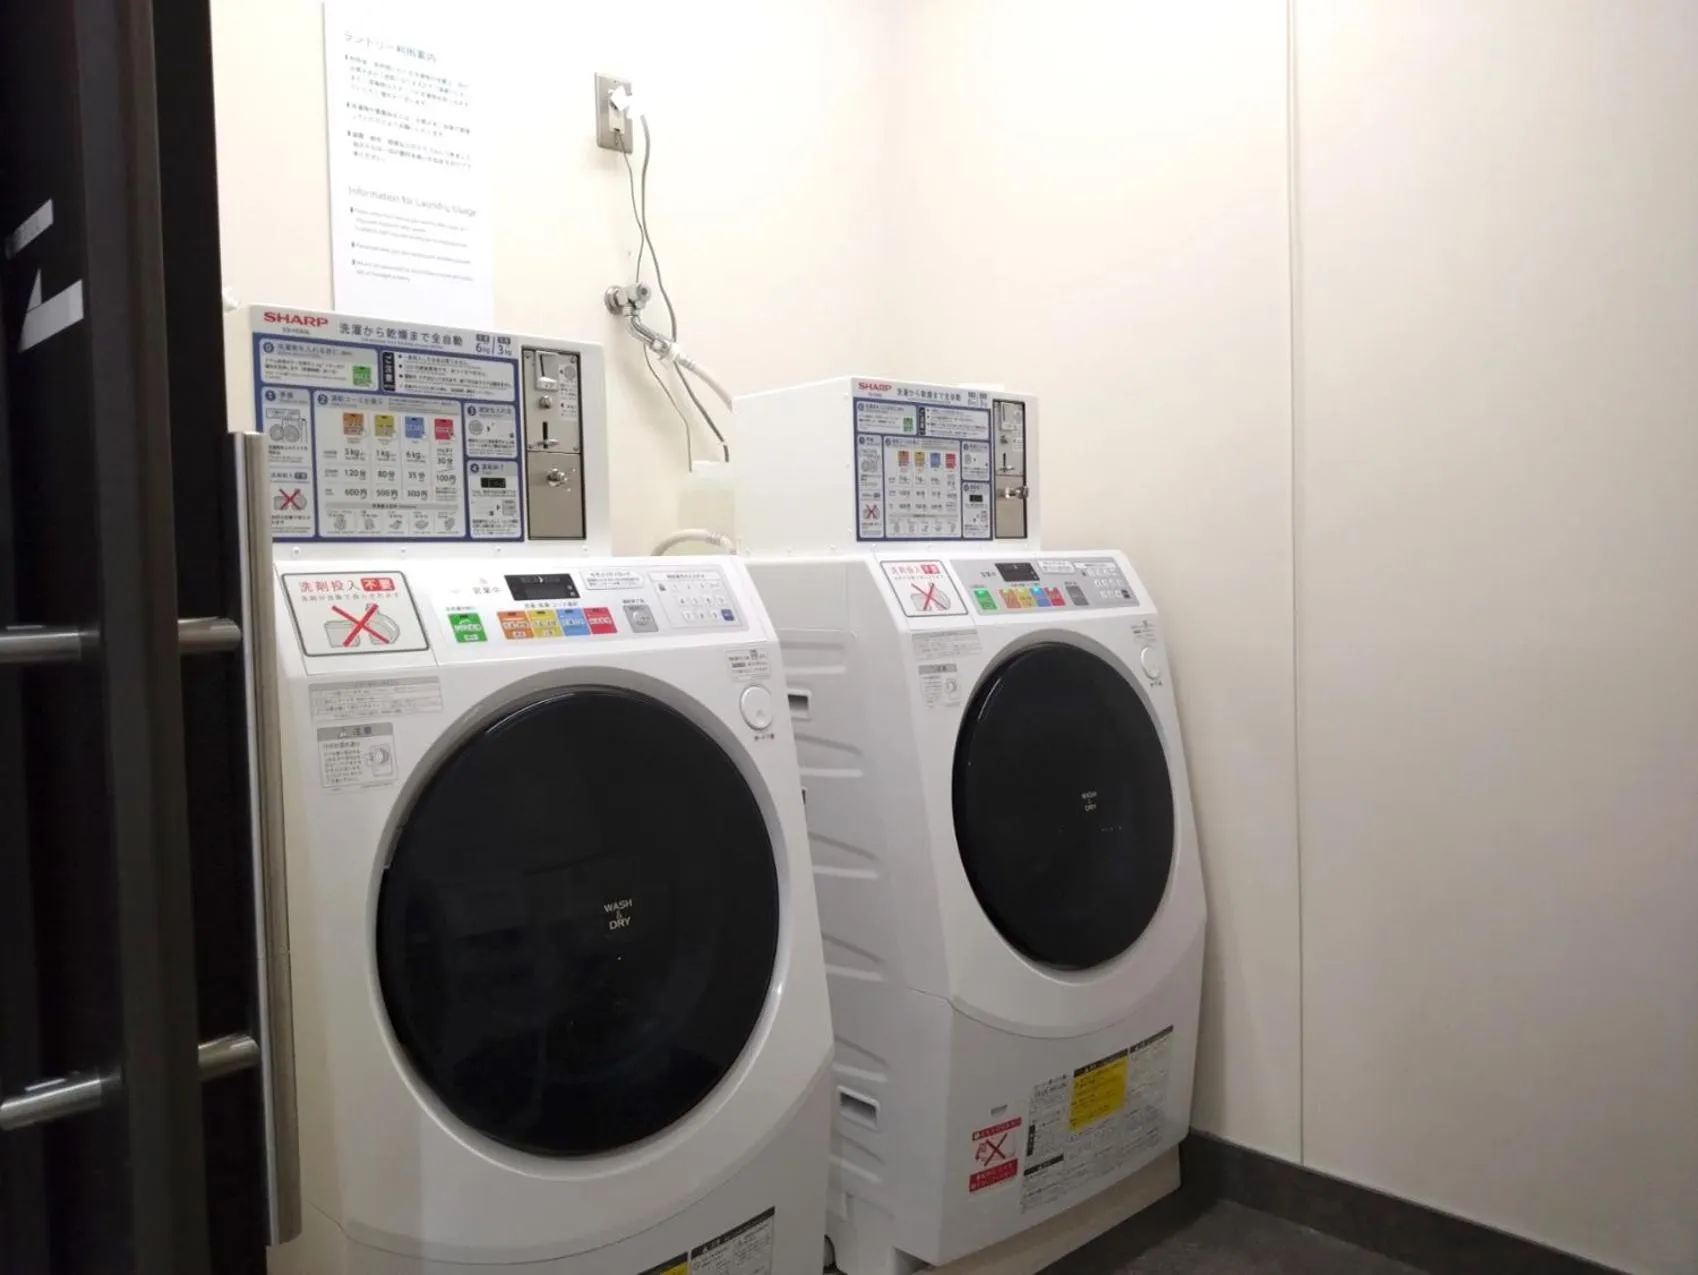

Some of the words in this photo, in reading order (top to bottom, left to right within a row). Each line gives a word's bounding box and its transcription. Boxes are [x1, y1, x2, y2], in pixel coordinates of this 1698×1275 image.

[263, 311, 329, 327] SHARP
[339, 322, 464, 346] 洗濯から乾燥まで全自動
[858, 382, 892, 392] SHARP
[299, 579, 360, 592] 洗剤投入
[603, 898, 633, 912] WASH
[608, 916, 631, 930] DRY
